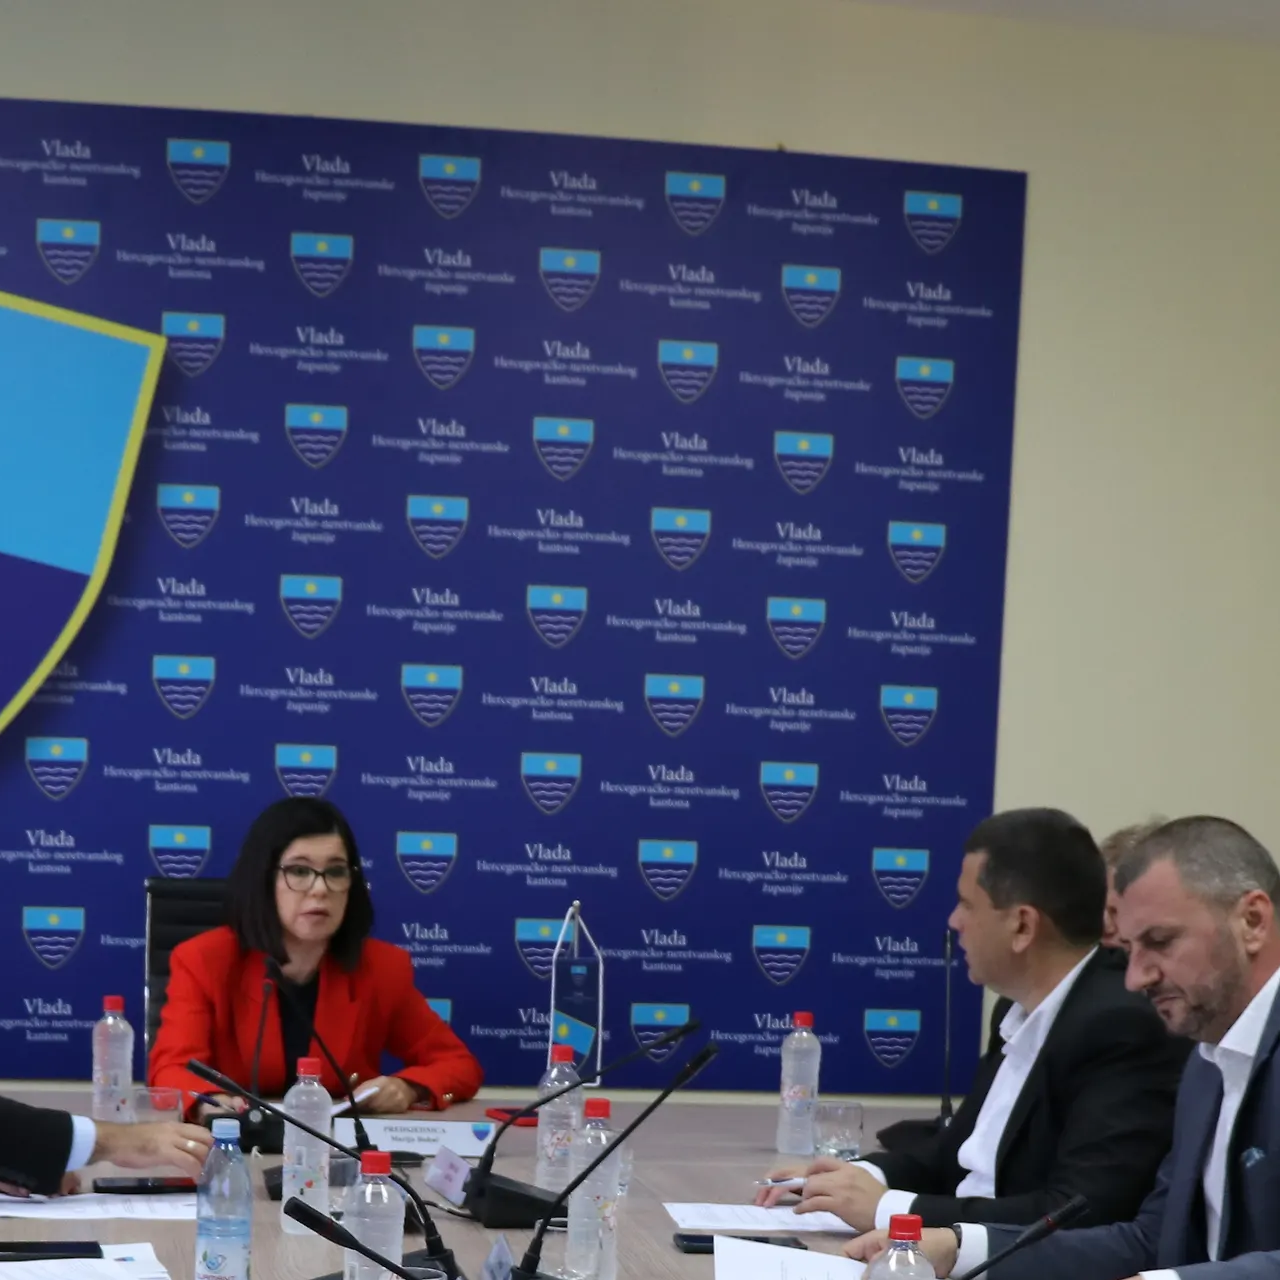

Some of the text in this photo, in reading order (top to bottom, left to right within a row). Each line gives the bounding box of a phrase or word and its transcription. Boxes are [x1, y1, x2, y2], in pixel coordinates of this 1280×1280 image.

[41, 137, 91, 158] Vlada
[302, 153, 351, 174] Vlada
[549, 169, 597, 190] Vlada
[791, 188, 838, 208] Vlada
[166, 232, 216, 252] Vlada
[424, 247, 472, 267] Vlada
[668, 263, 715, 283] Vlada
[906, 281, 952, 300] Vlada
[296, 325, 345, 345] Vlada
[542, 339, 590, 359] Vlada
[784, 356, 830, 375] Vlada
[417, 417, 466, 437] Vlada
[661, 431, 707, 450] Vlada
[898, 447, 944, 465] Vlada
[662, 465, 703, 477] kantona
[290, 497, 339, 516] Vlada
[536, 508, 584, 527] Vlada
[776, 522, 822, 540] Vlada
[538, 542, 579, 554] kantona
[157, 576, 206, 595] Vlada
[412, 587, 460, 606] Vlada
[654, 598, 701, 616] Vlada
[158, 611, 201, 623] kantona
[890, 611, 936, 629] Vlada
[655, 631, 696, 643] kantona
[285, 666, 334, 685] Vlada
[530, 676, 577, 694] Vlada
[769, 686, 815, 705] Vlada
[531, 709, 572, 721] kantona
[153, 747, 202, 766] Vlada
[406, 755, 454, 774] Vlada
[647, 764, 694, 782] Vlada
[155, 781, 197, 793] kantona
[882, 774, 928, 792] Vlada
[649, 797, 689, 808] kantona
[26, 828, 75, 847] Vlada
[524, 842, 571, 860] Vlada
[762, 851, 808, 868] Vlada
[28, 863, 71, 874] kantona
[526, 875, 567, 887] kantona
[401, 922, 449, 940] Vlada
[640, 928, 687, 946] Vlada
[874, 936, 919, 953] Vlada
[642, 961, 682, 972] kantona
[23, 997, 73, 1015] Vlada
[25, 1031, 68, 1042] kantona
